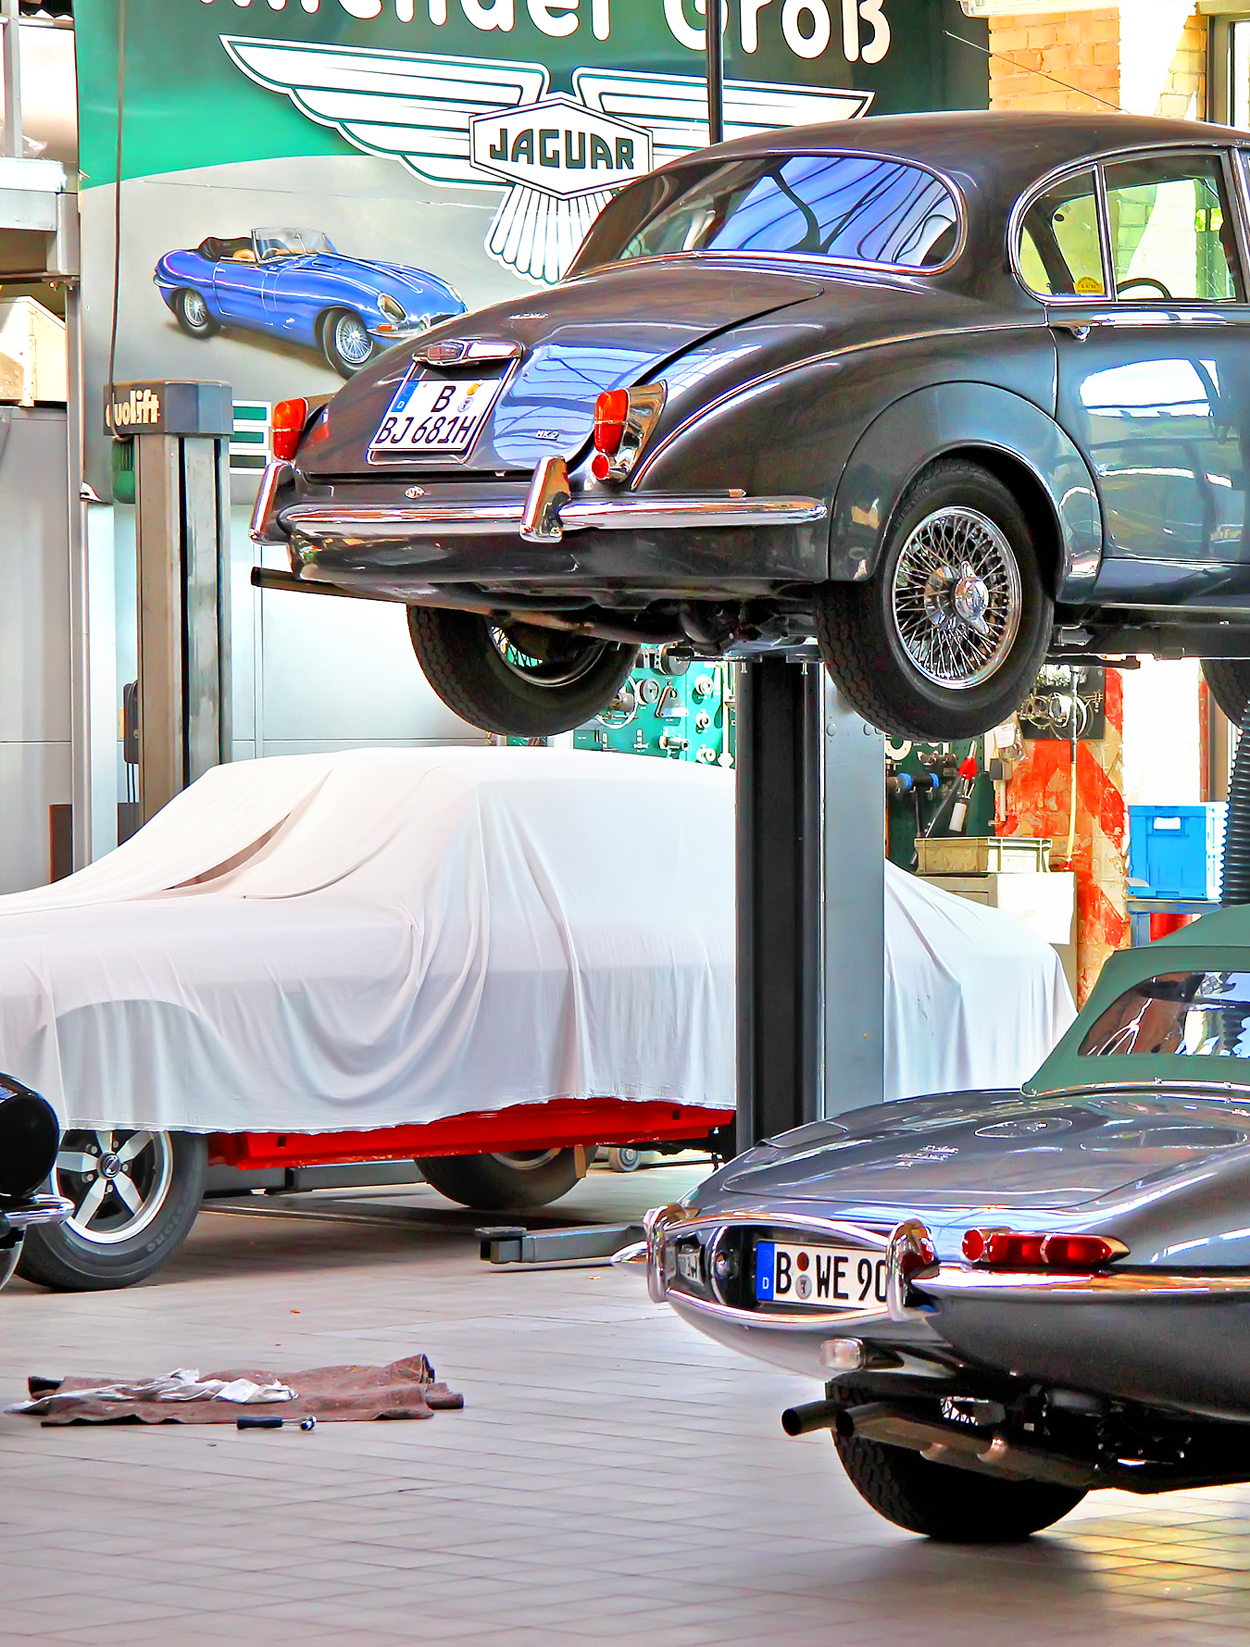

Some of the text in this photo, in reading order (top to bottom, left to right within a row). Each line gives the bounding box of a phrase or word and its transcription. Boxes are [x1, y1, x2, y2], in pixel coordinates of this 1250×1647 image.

[489, 128, 634, 170] JAGUAR
[430, 385, 456, 412] B
[374, 416, 477, 444] BJ 681H
[776, 1251, 792, 1294] B
[816, 1255, 849, 1299] WE
